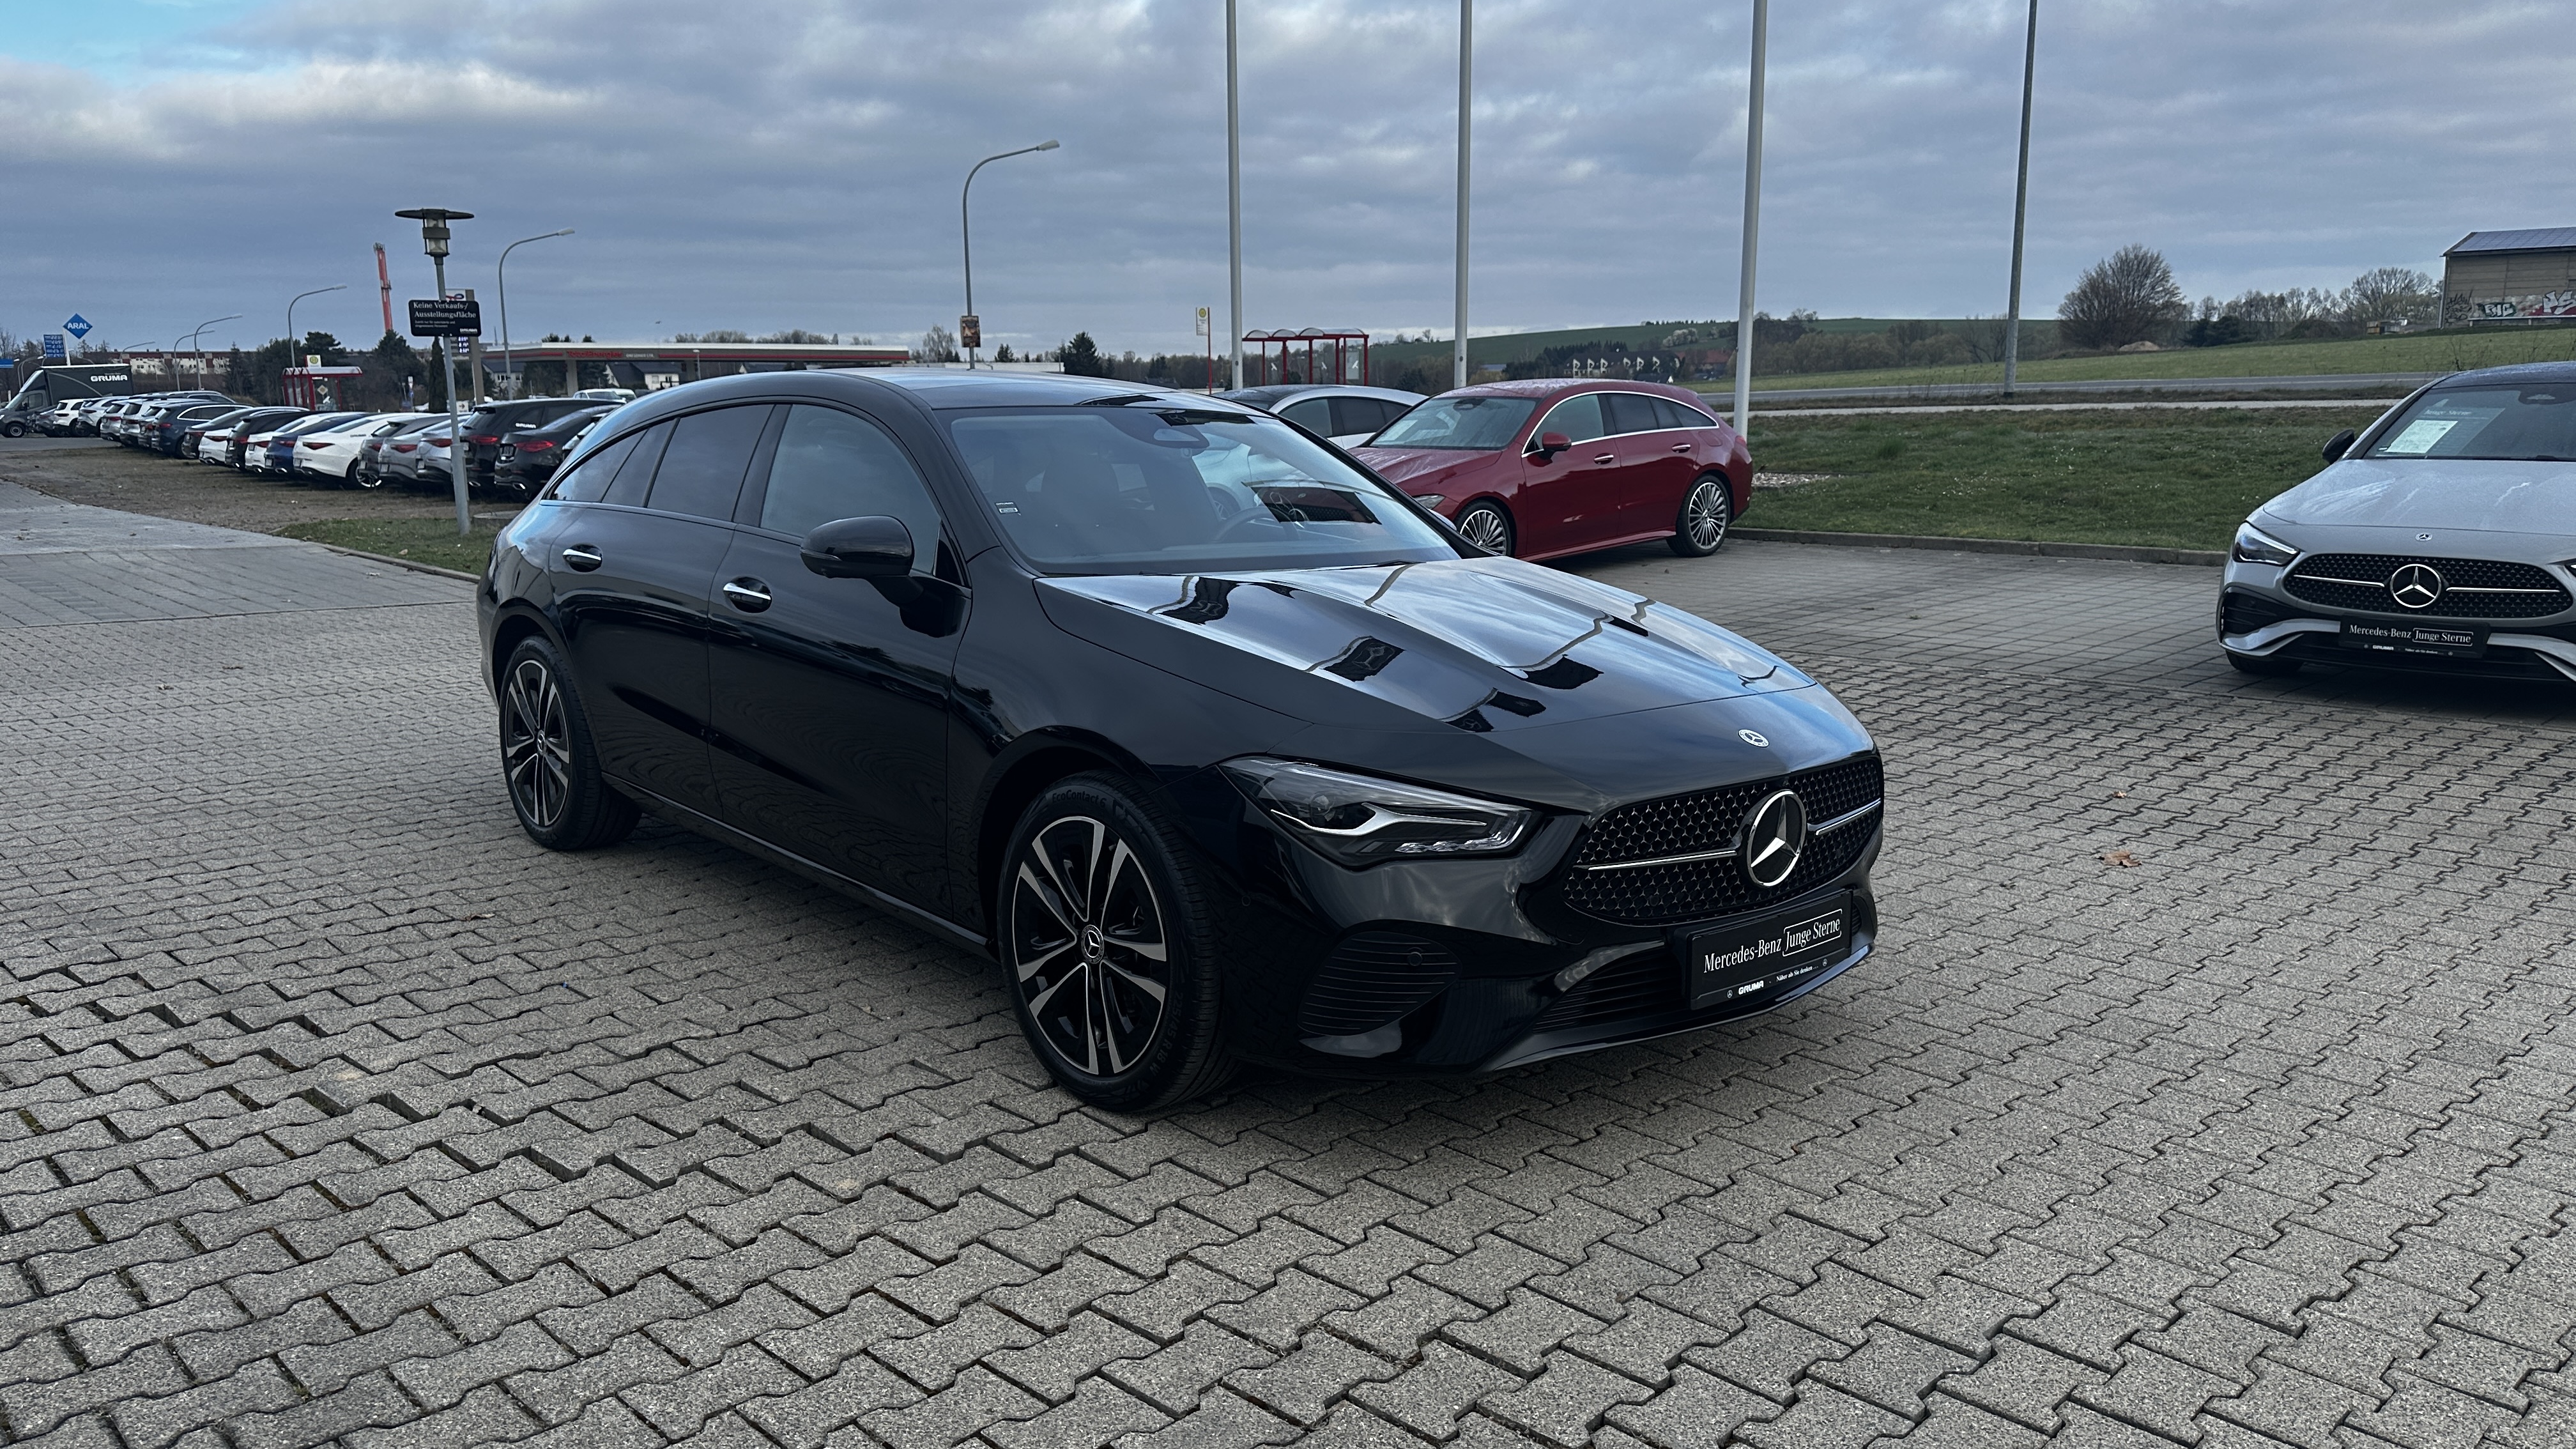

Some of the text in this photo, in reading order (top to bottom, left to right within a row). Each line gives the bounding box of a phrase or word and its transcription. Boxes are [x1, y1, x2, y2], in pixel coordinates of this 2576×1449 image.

[2349, 624, 2471, 643] Mercedes-Benz Junge Sterne
[1052, 790, 1107, 808] EcoContact 6
[1703, 918, 1841, 974] Mercedes-Benz Junge Sterne
[1738, 980, 1764, 995] GRUMA
